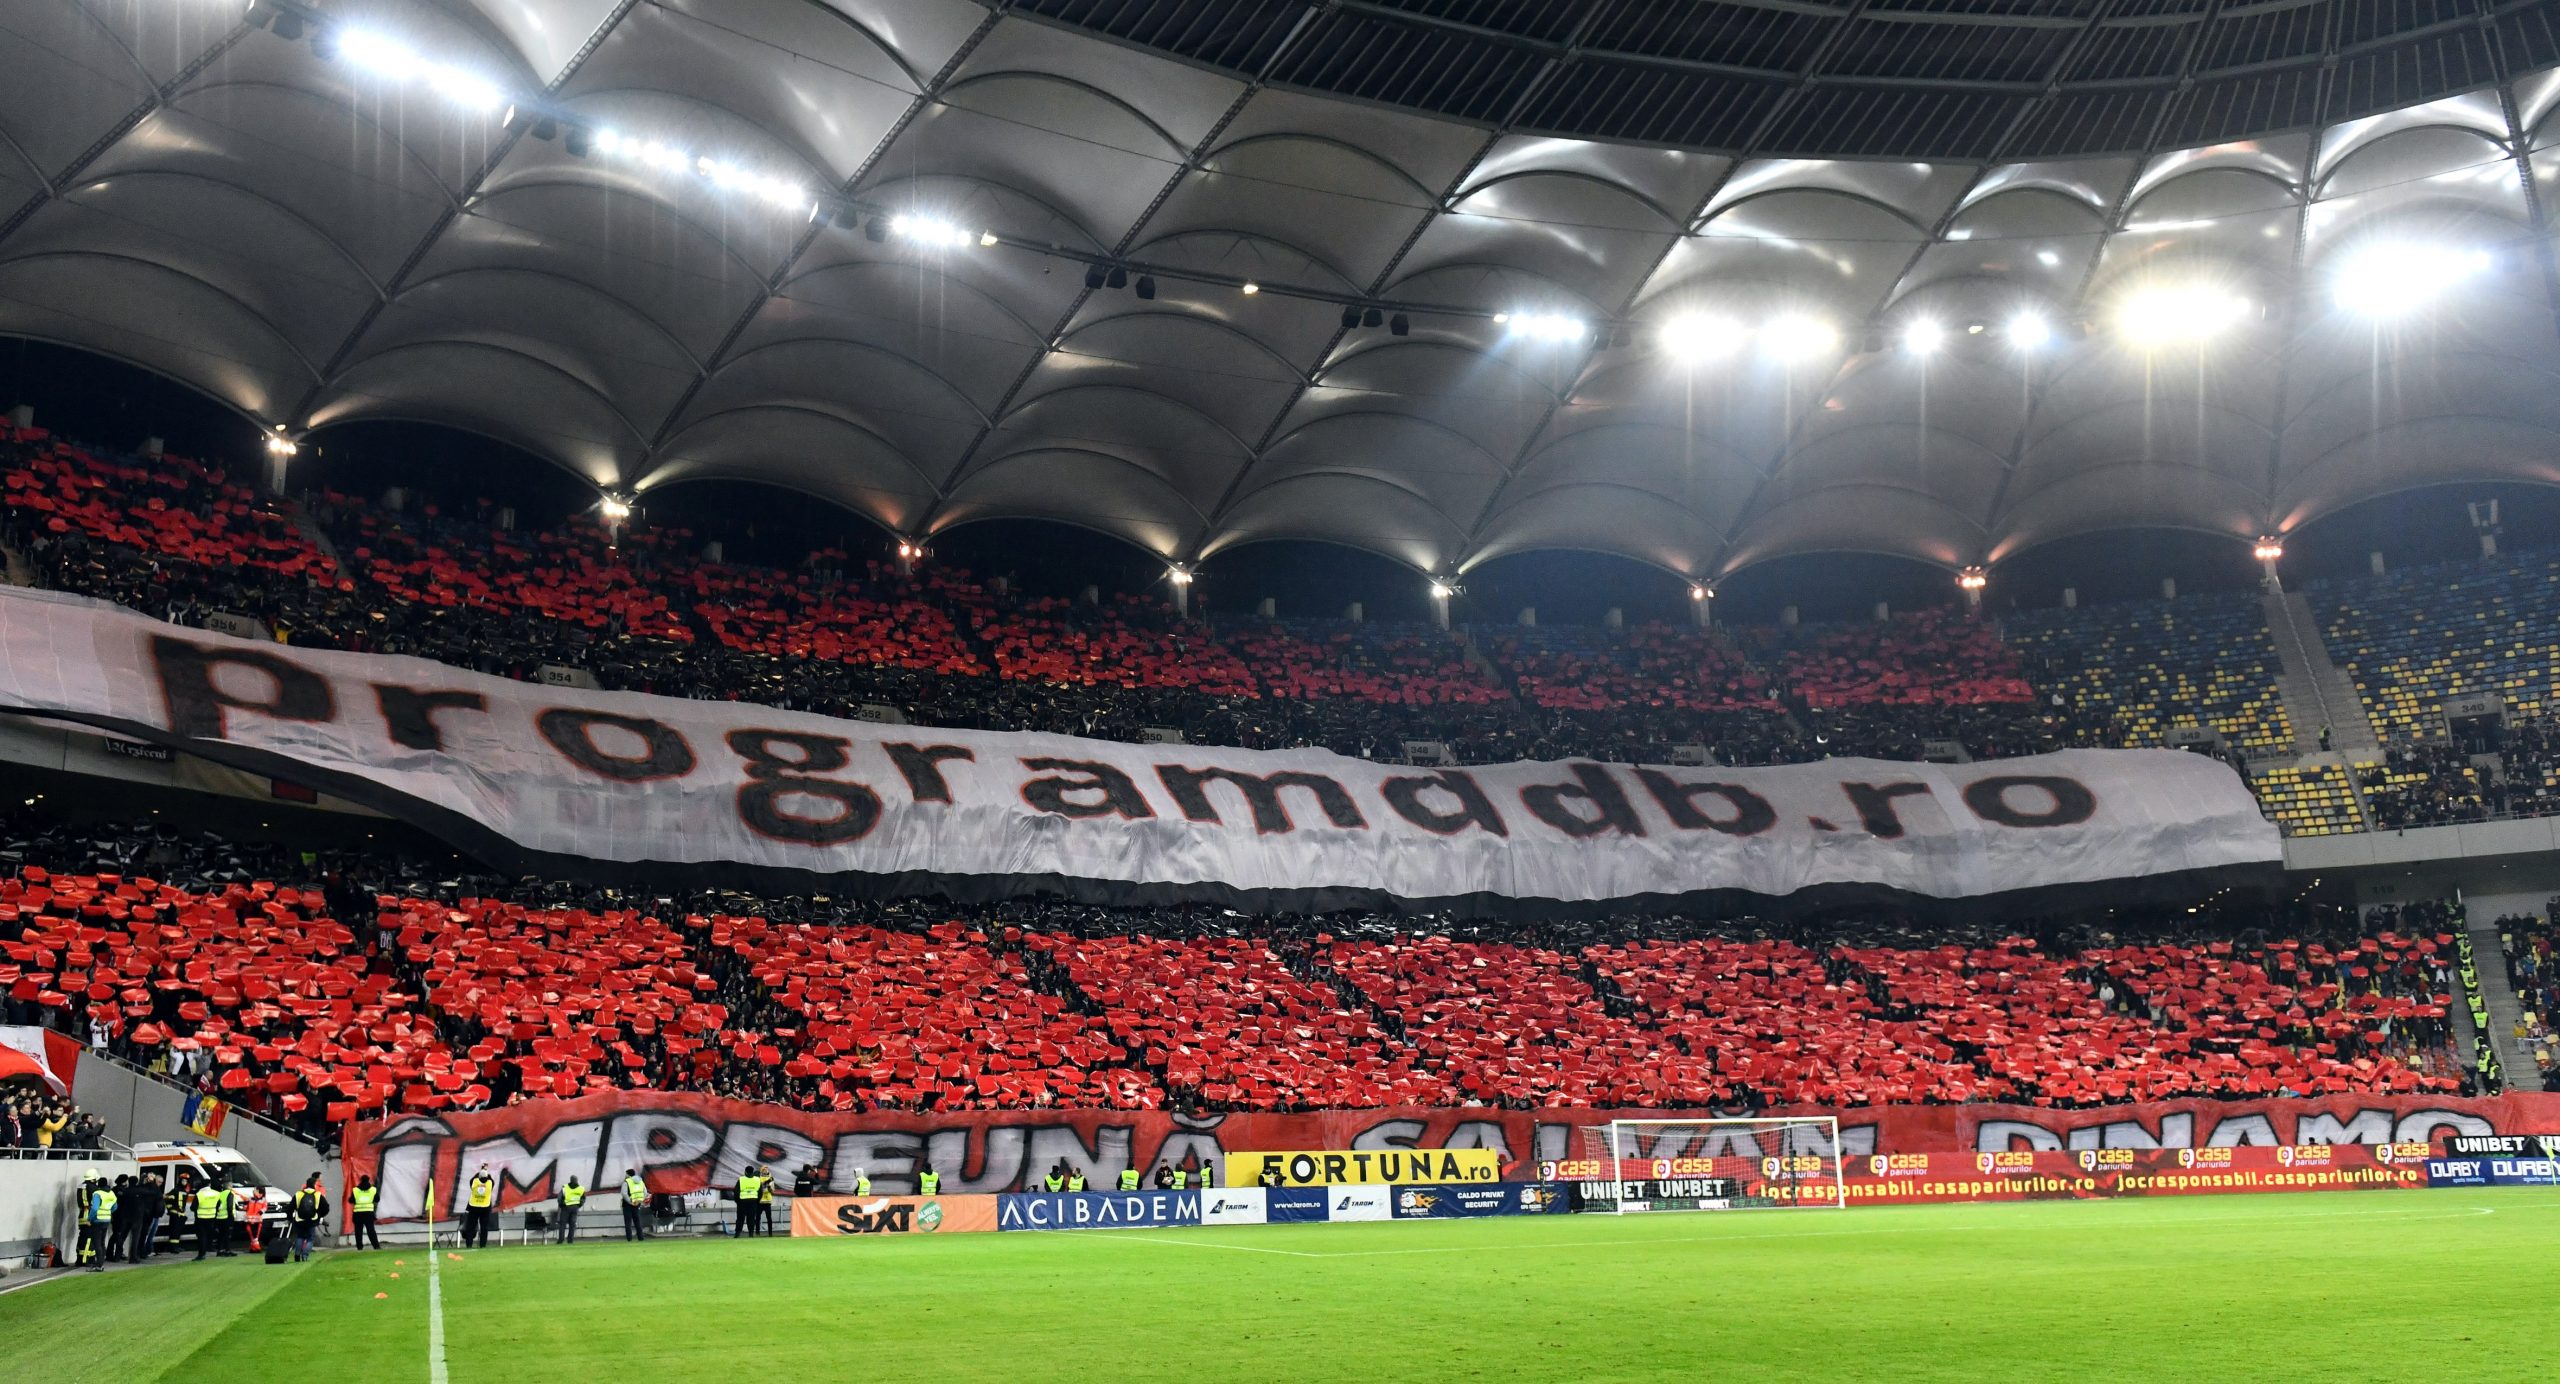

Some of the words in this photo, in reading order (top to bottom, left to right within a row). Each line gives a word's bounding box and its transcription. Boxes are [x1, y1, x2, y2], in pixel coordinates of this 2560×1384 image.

[549, 671, 572, 683] 354
[861, 709, 881, 719] 352
[2461, 703, 2486, 713] 340
[1410, 746, 1429, 754] 348
[2394, 1143, 2430, 1157] casa
[2455, 1137, 2525, 1152] UNIBET
[1996, 1152, 2033, 1166] casa
[2098, 1149, 2134, 1163] casa
[2196, 1148, 2232, 1161] casa
[2295, 1145, 2331, 1159] casa
[371, 1109, 1231, 1223] ÎMPREUNĂ
[1558, 1160, 1601, 1176] casa
[1672, 1158, 1713, 1173] casa
[1889, 1154, 1929, 1169] casa
[2097, 1162, 2133, 1171] pariurilor
[2196, 1160, 2232, 1169] pariurilor
[2295, 1158, 2331, 1167] pariurilor
[1889, 1168, 1928, 1177] pariurilor
[1995, 1165, 2033, 1174] pariurilor
[2430, 1161, 2481, 1178] DURBY
[2117, 1168, 2417, 1192] jocresponsabil.casapariurilor.ro
[1457, 1192, 1480, 1200] CALDO
[1481, 1191, 1505, 1199] PRIVAT
[1580, 1181, 1646, 1200] UNIBET
[1659, 1179, 1725, 1198] UNIBET
[1001, 1194, 1200, 1226] ACIBADEM
[1465, 1201, 1499, 1209] SECURITY
